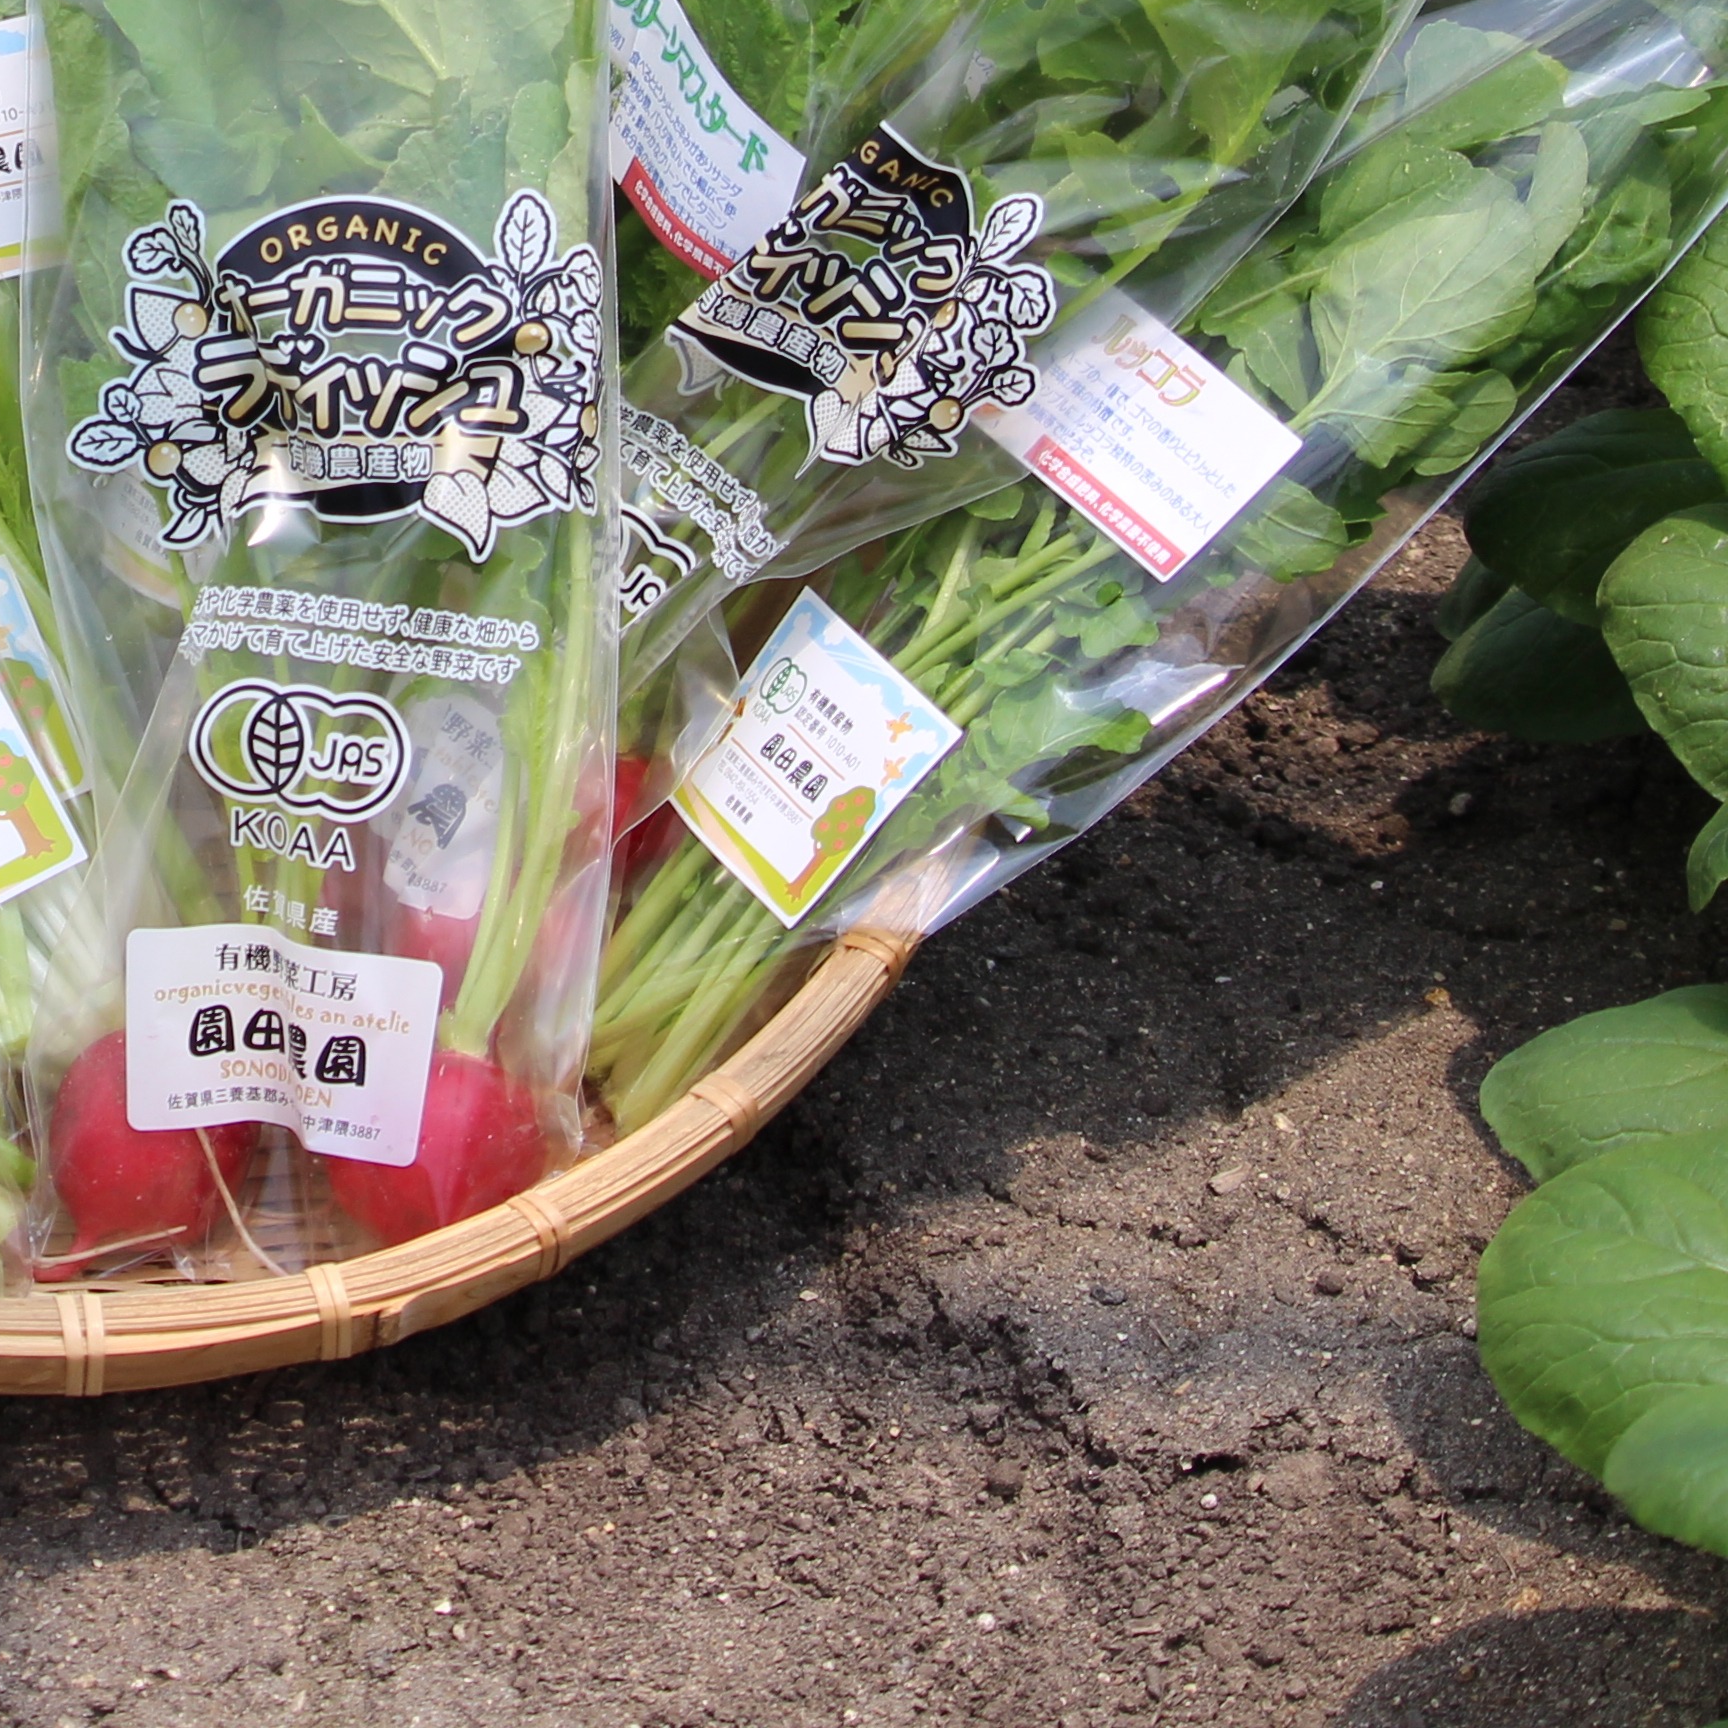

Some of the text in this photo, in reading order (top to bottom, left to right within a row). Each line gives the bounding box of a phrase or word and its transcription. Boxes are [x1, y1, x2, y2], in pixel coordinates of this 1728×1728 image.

[849, 140, 954, 208] GANIC
[261, 216, 448, 265] ORGANIC
[1091, 313, 1207, 407] ルッコラ
[290, 439, 434, 480] 有機農産物
[793, 705, 863, 773] 認定番号 1010-A01
[808, 688, 854, 736] 有機農産物
[309, 737, 389, 783] JAS
[760, 732, 829, 803] 園田農園
[231, 808, 355, 870] KOAA
[243, 885, 338, 936] 佐賀県産
[320, 1009, 346, 1024] an
[188, 1004, 367, 1087] 園田農園
